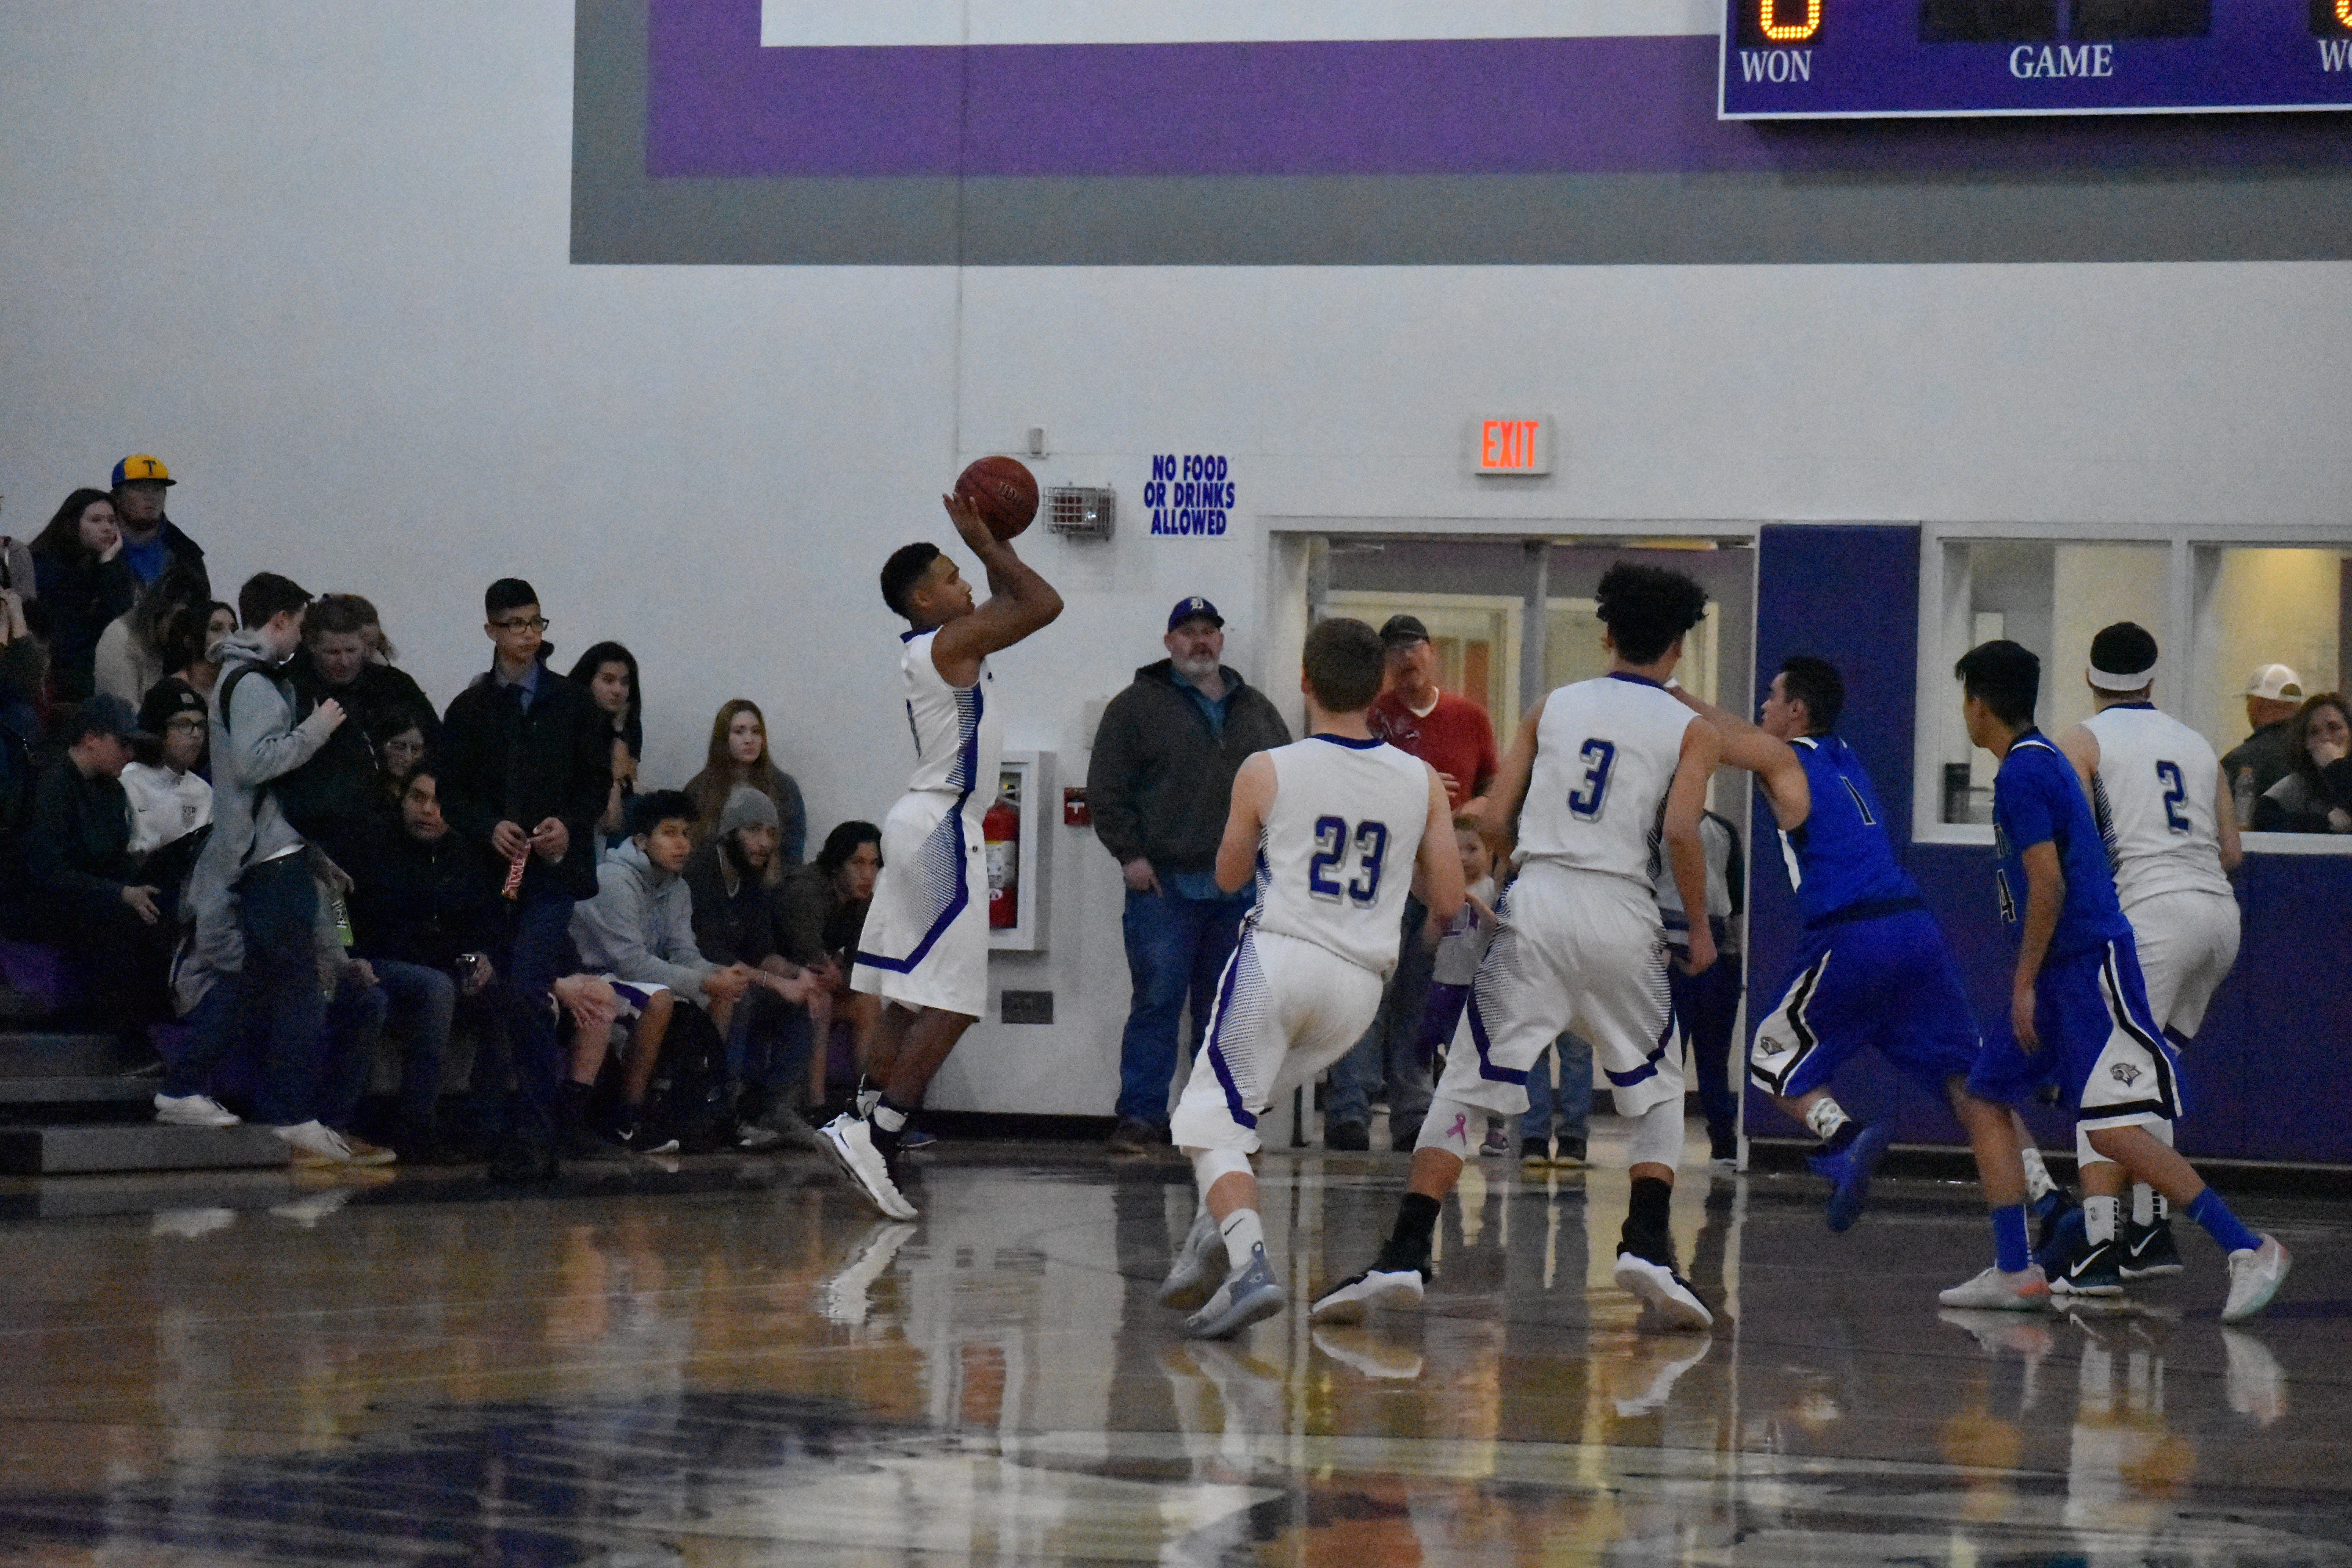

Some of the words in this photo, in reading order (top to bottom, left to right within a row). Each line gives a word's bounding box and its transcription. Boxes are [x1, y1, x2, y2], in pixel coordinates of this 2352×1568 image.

[1740, 50, 1812, 82] WON
[2010, 45, 2113, 78] GAME
[1481, 421, 1539, 468] EXIT
[143, 459, 157, 476] T
[1152, 454, 1176, 481] NO
[1183, 455, 1227, 481] FOOD
[1144, 481, 1166, 508] OR
[1174, 481, 1236, 509] DRINKS
[1151, 508, 1227, 535] ALLOWED
[1568, 737, 1617, 824] 3
[2156, 759, 2191, 835] 2
[1308, 814, 1392, 909] 23
